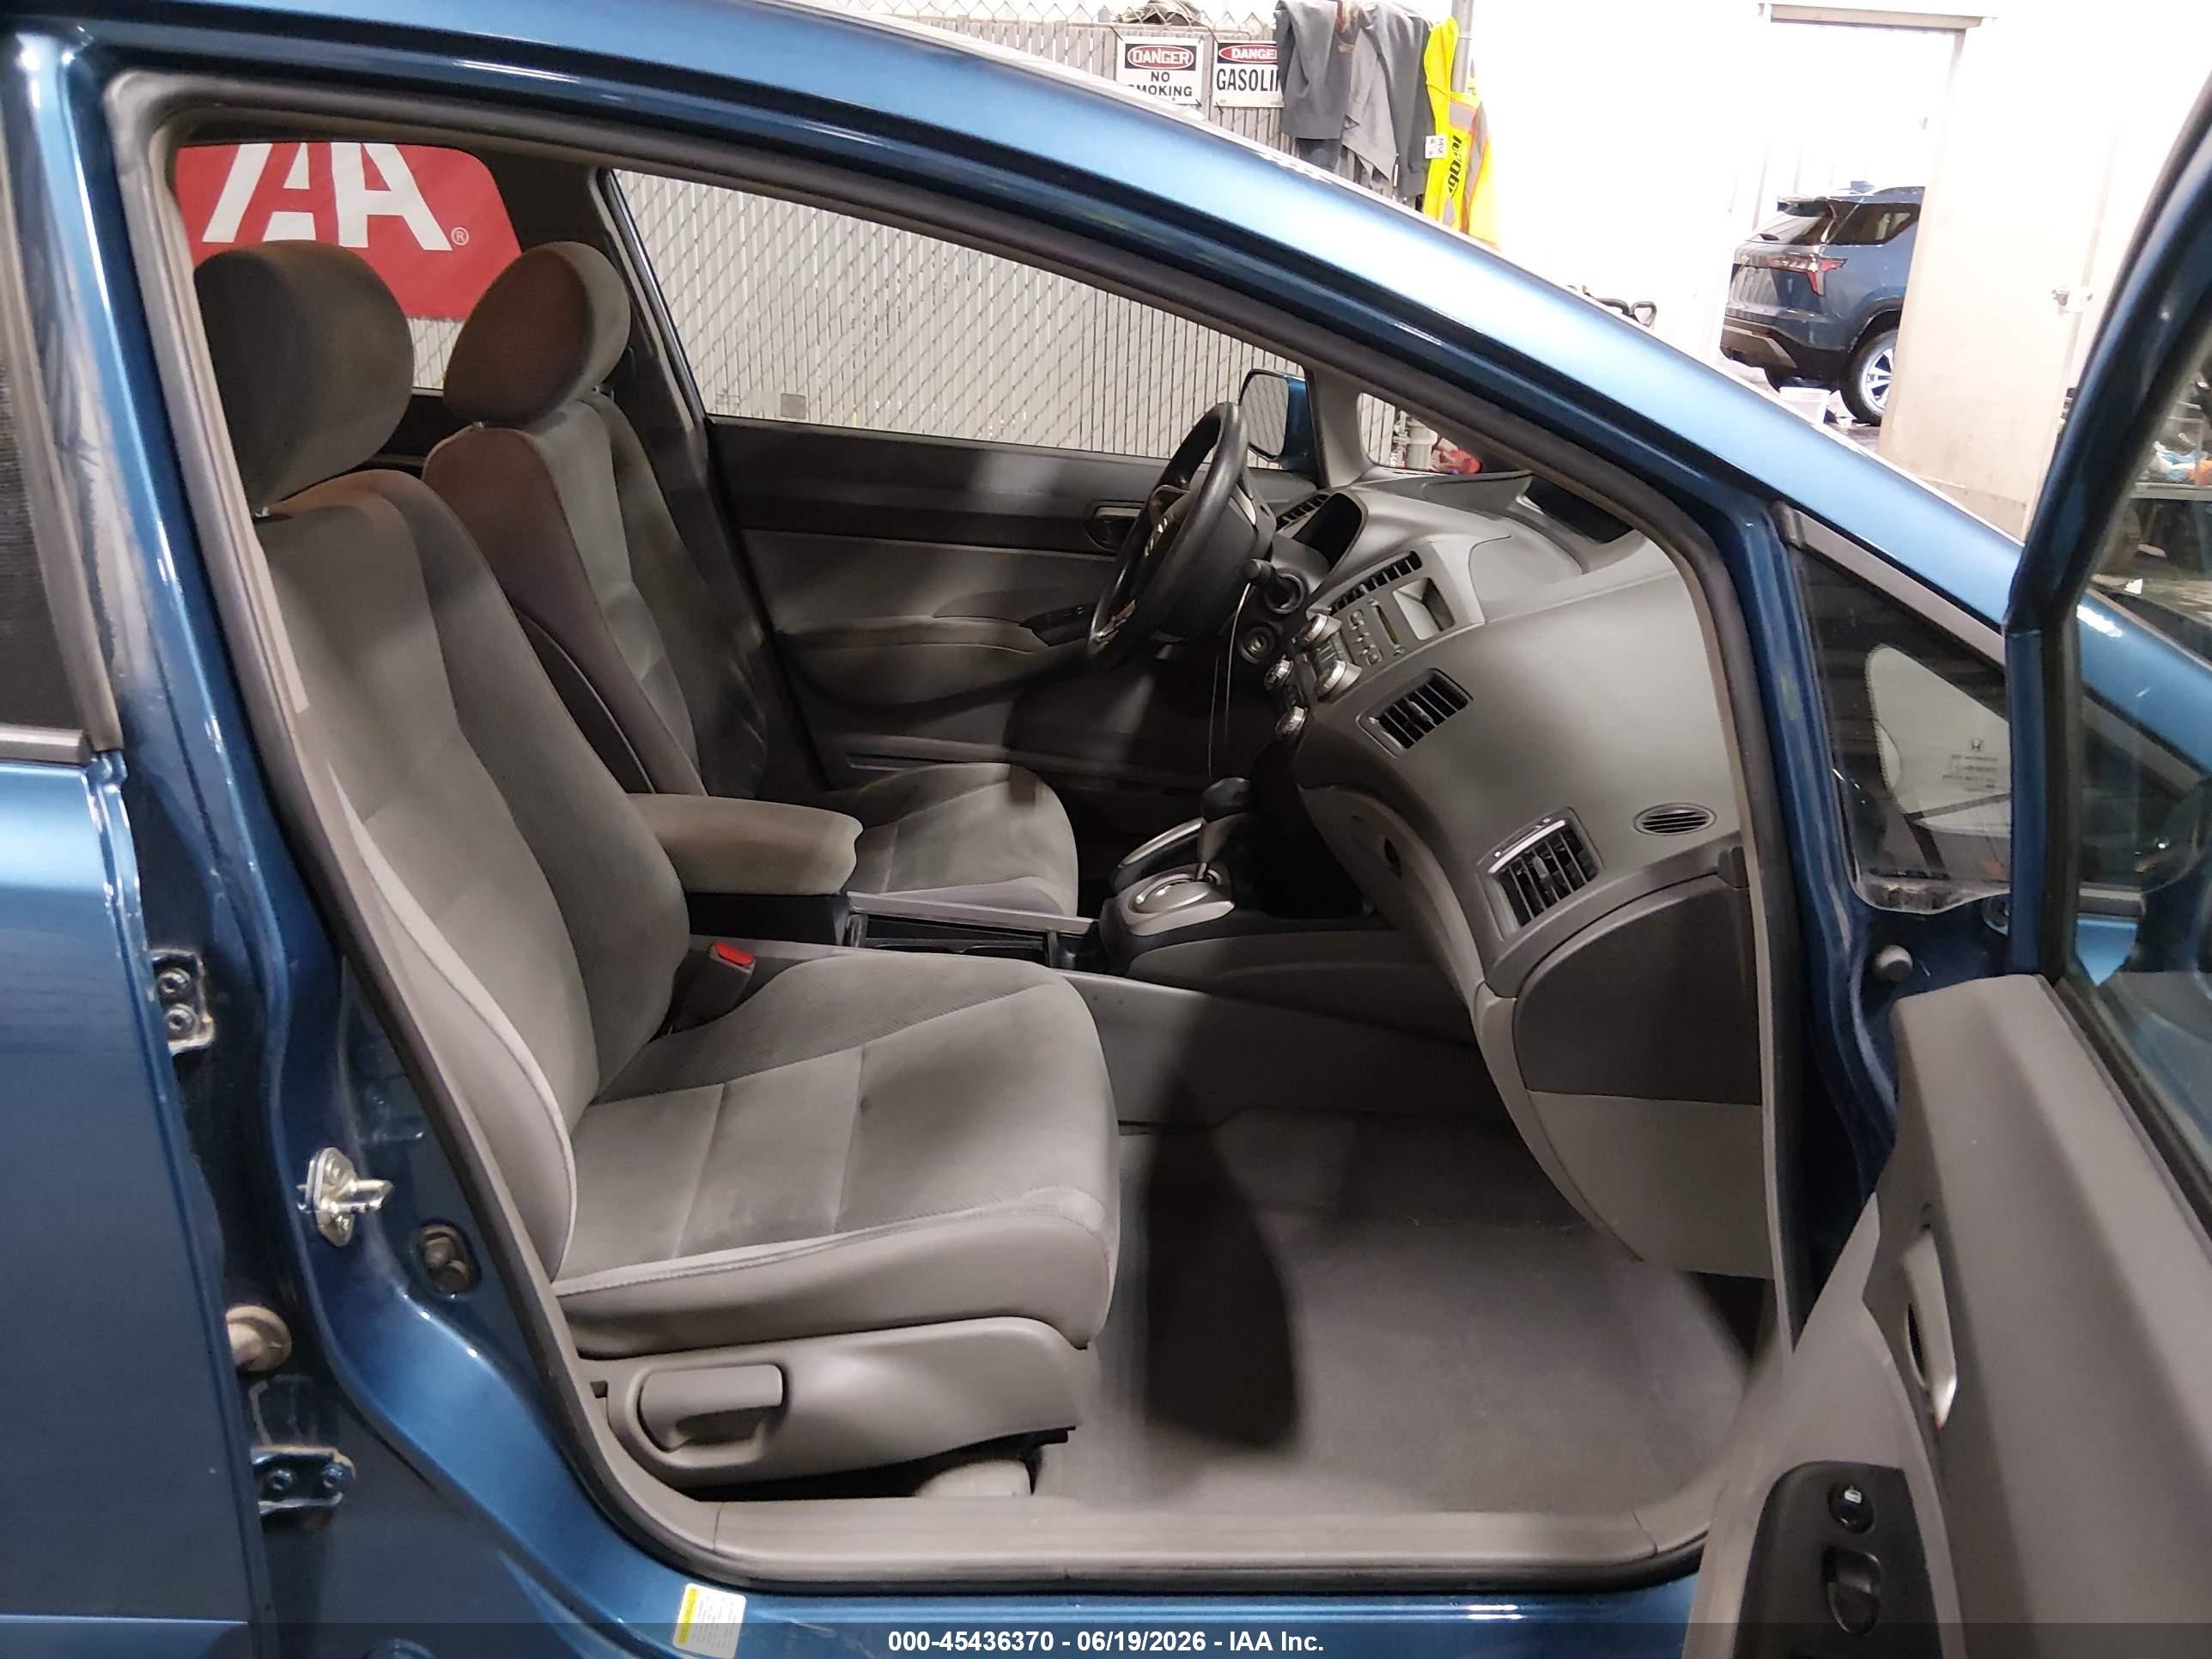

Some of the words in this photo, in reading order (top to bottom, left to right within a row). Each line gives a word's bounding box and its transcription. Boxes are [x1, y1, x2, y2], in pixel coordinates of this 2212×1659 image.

[1133, 48, 1190, 65] DANGER
[1231, 47, 1278, 60] DANGE
[1151, 70, 1170, 82] NO
[1127, 84, 1193, 97] MOKING
